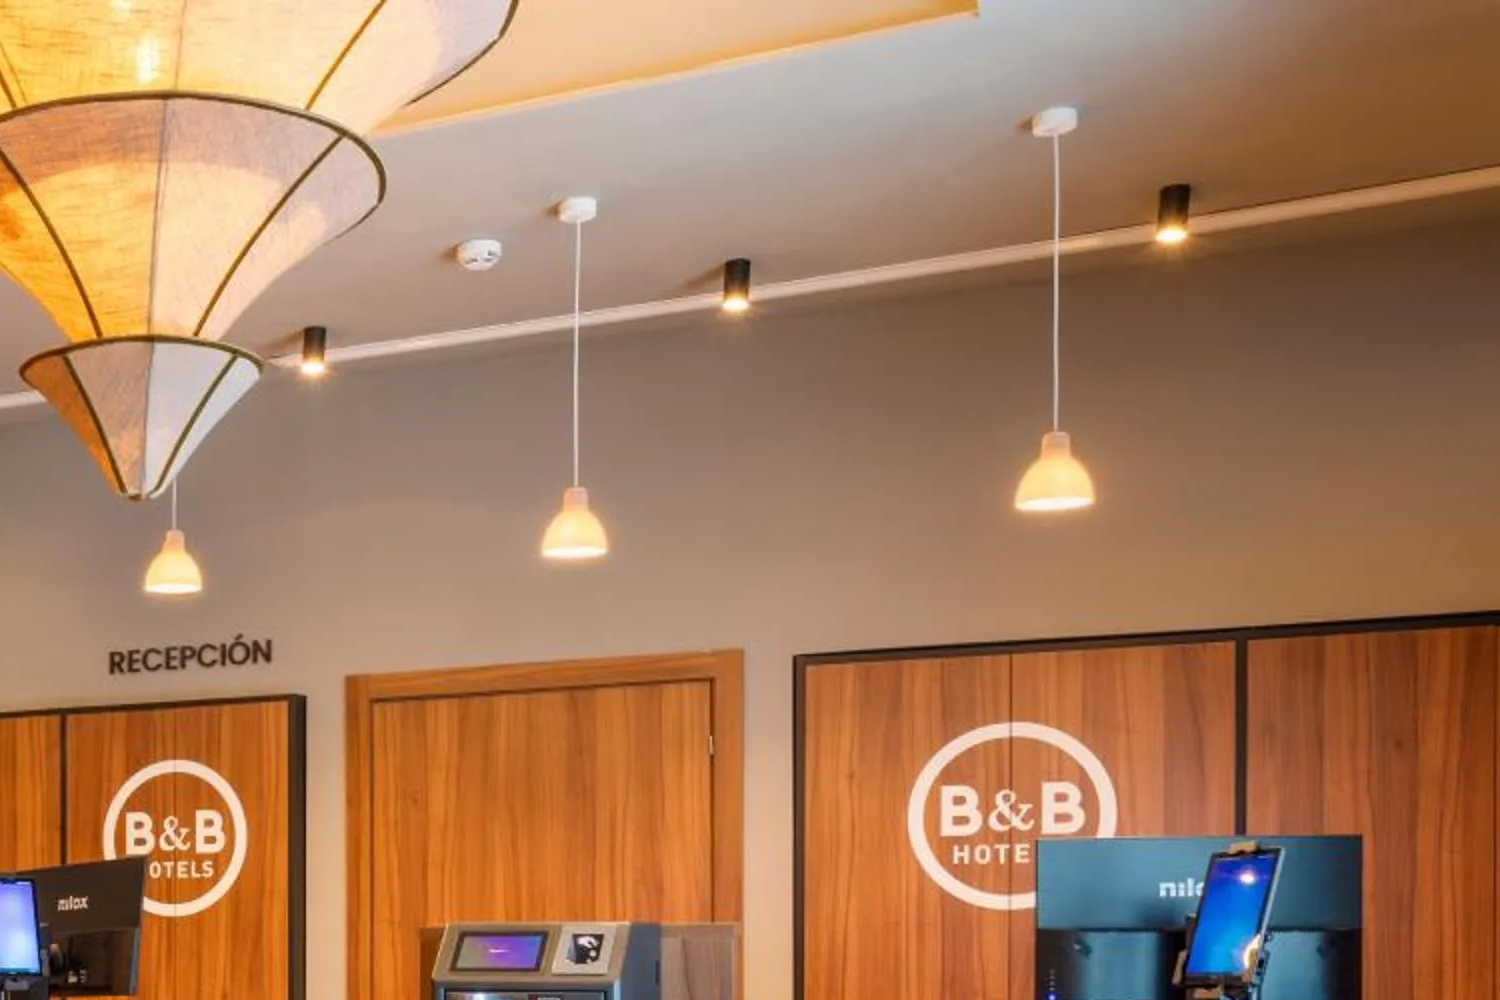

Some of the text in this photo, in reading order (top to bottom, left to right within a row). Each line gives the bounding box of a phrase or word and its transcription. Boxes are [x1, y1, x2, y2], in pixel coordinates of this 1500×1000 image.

[108, 633, 273, 676] RECEPCIÓN
[940, 780, 1087, 838] B&B
[125, 808, 227, 857] B&B
[148, 859, 216, 880] OTELS
[952, 843, 1031, 866] HOTE
